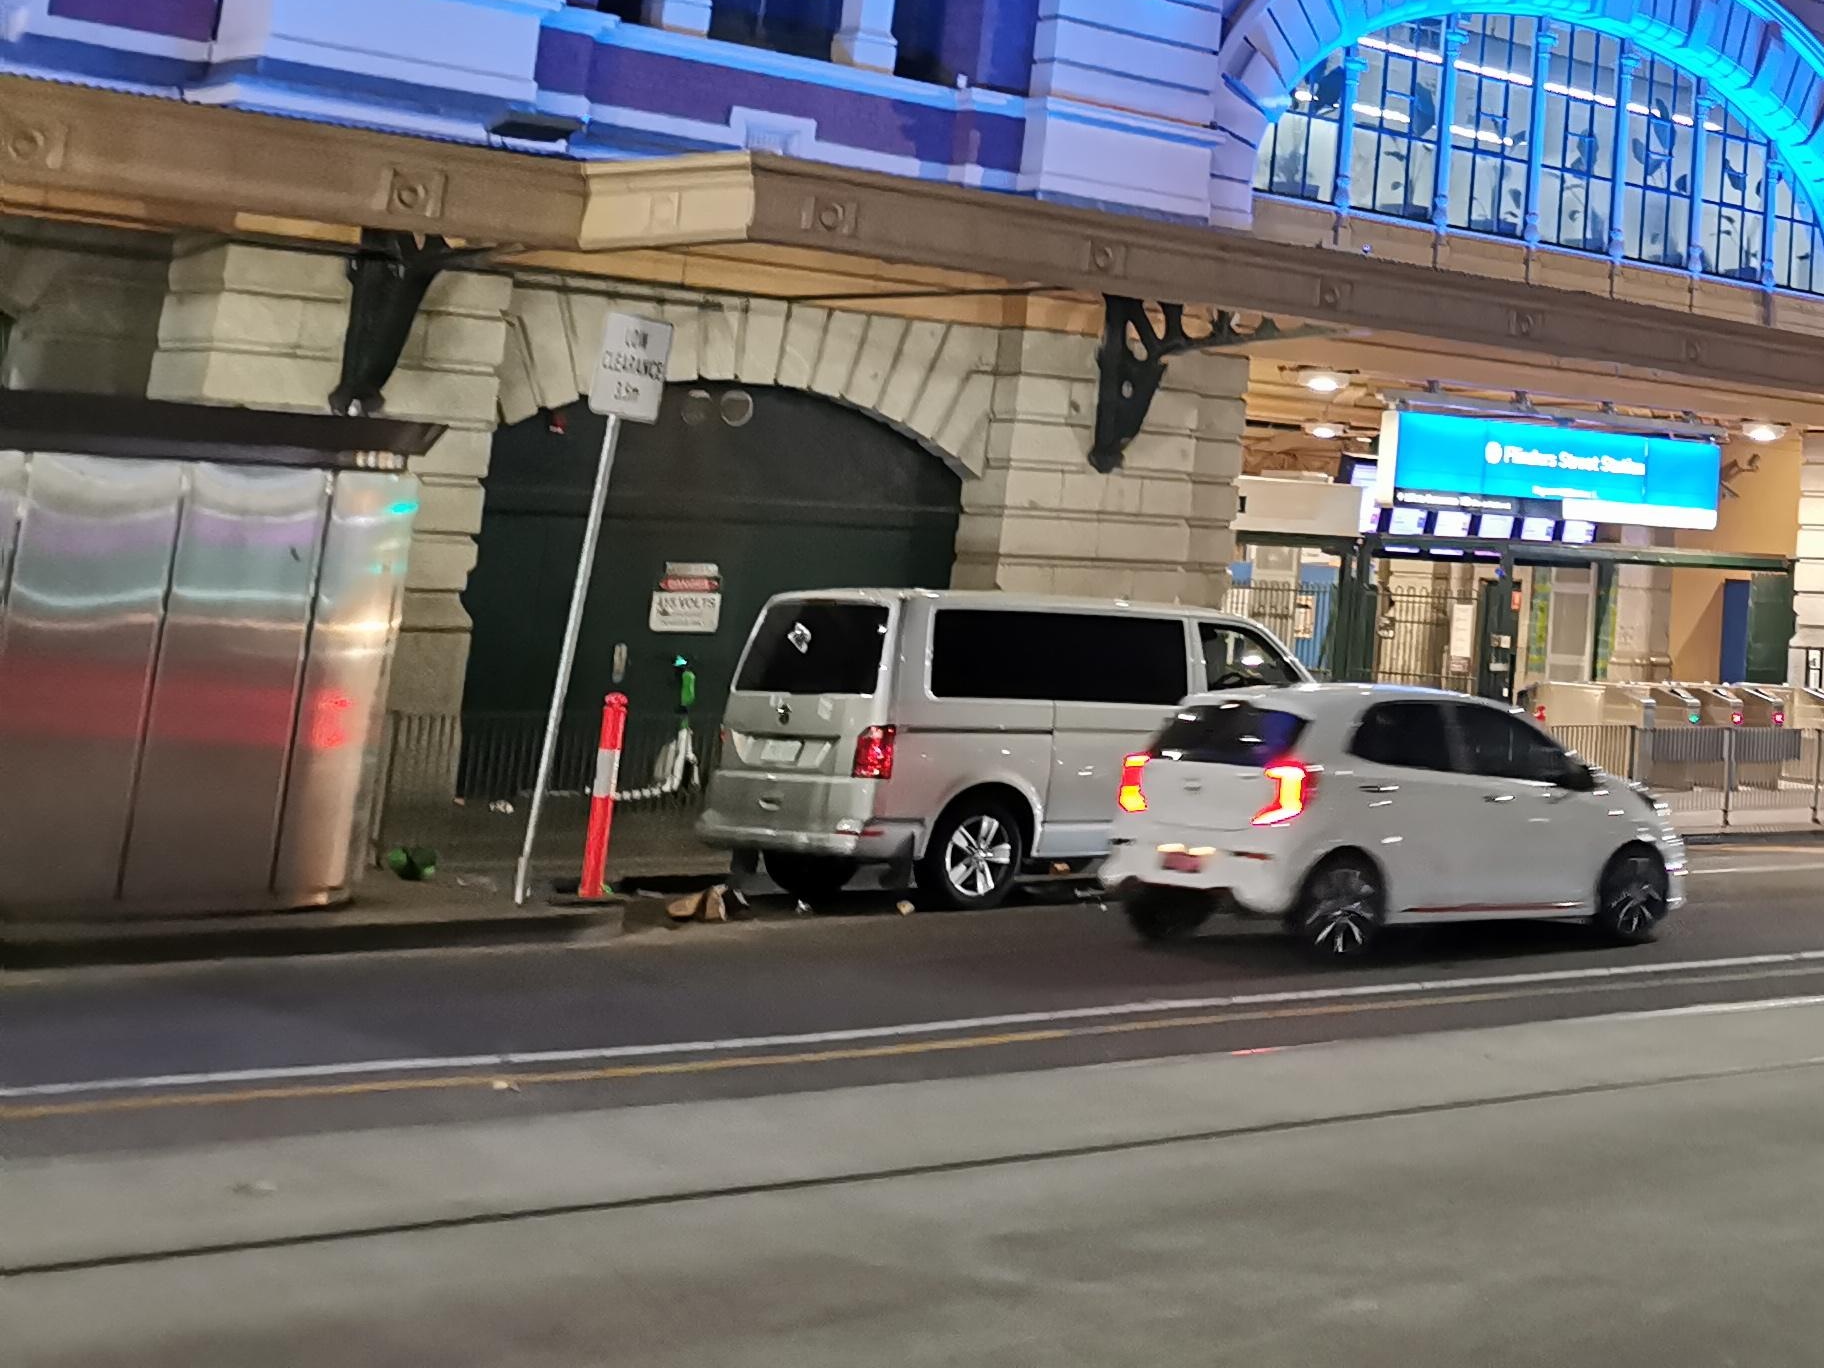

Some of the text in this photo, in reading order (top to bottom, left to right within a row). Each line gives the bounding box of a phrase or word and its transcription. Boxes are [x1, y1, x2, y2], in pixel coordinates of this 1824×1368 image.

[602, 349, 664, 382] CLEARANCE
[1503, 445, 1558, 468] Flinders
[1558, 450, 1600, 472] Street
